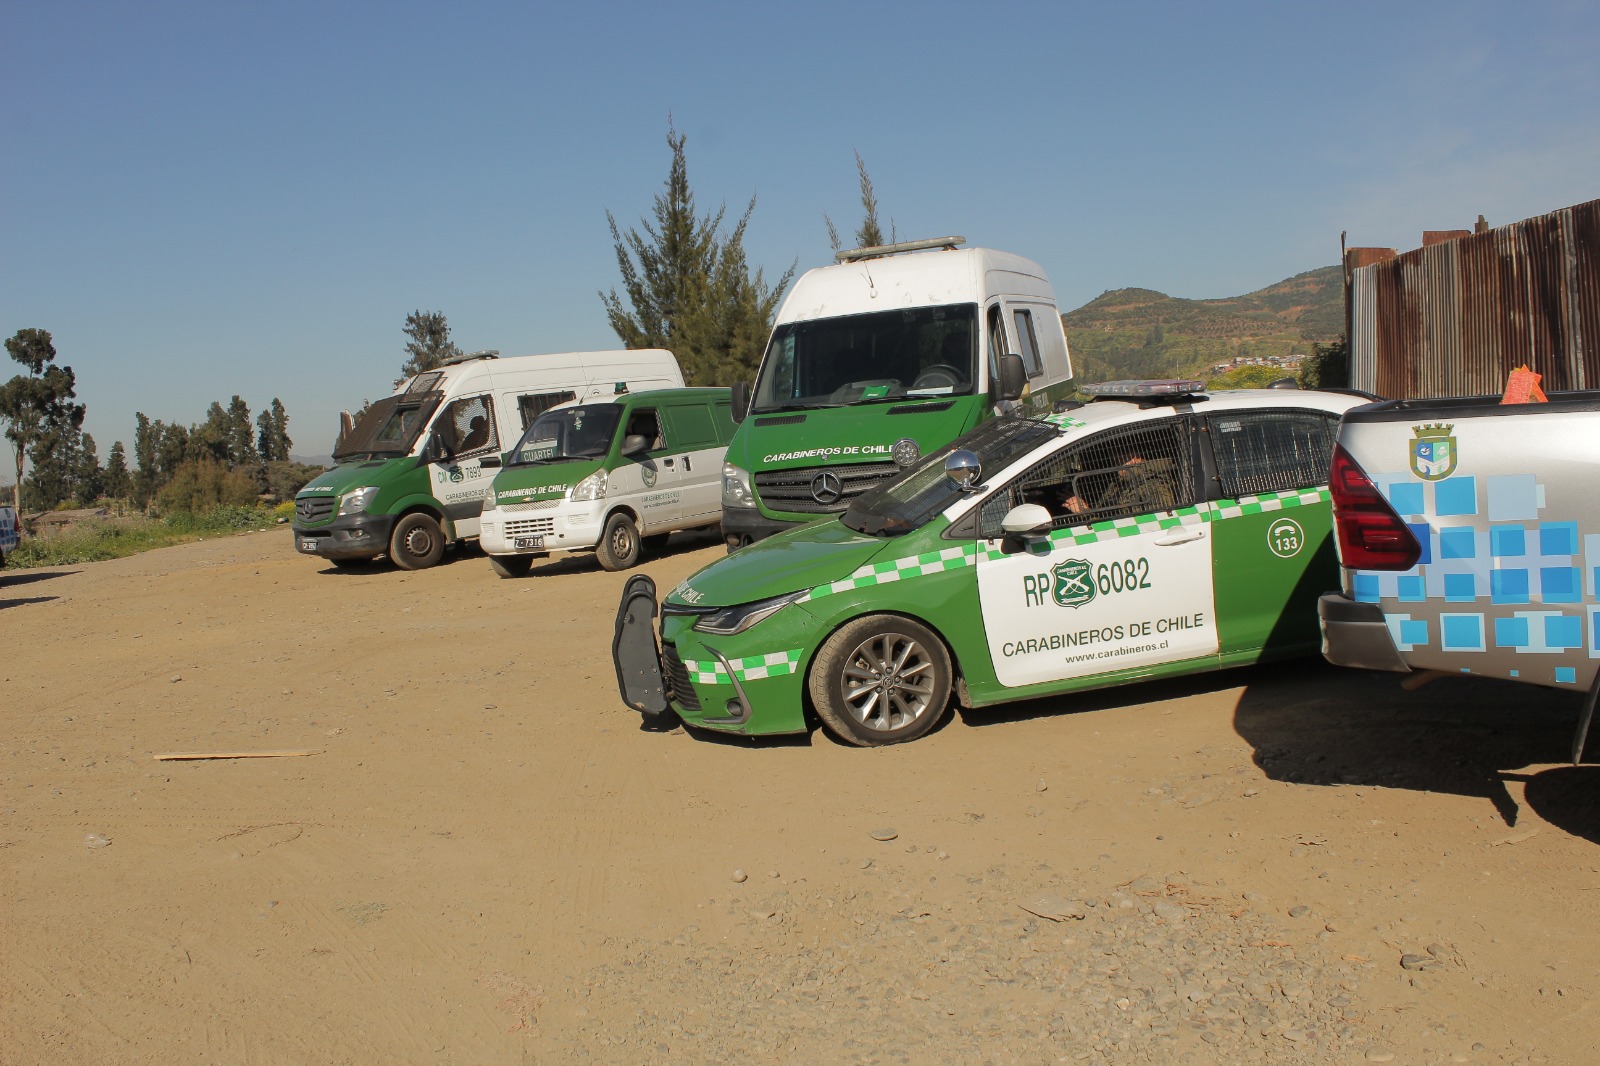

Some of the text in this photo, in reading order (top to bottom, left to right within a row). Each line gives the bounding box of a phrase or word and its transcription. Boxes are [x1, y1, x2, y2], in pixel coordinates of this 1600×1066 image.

[763, 447, 840, 463] CARABINEROS
[843, 446, 859, 455] DE
[437, 470, 448, 484] CM
[445, 490, 478, 500] CARABINEROS
[498, 486, 537, 499] CARABINEROS
[538, 485, 547, 494] DE
[548, 484, 568, 493] CHILE
[1275, 533, 1298, 553] 133
[1023, 556, 1151, 608] RP 6082
[681, 588, 705, 604] CHILE
[1002, 613, 1204, 657] CARABINEROS DE CHILE
[1065, 639, 1170, 664] www.carabineros.cl
